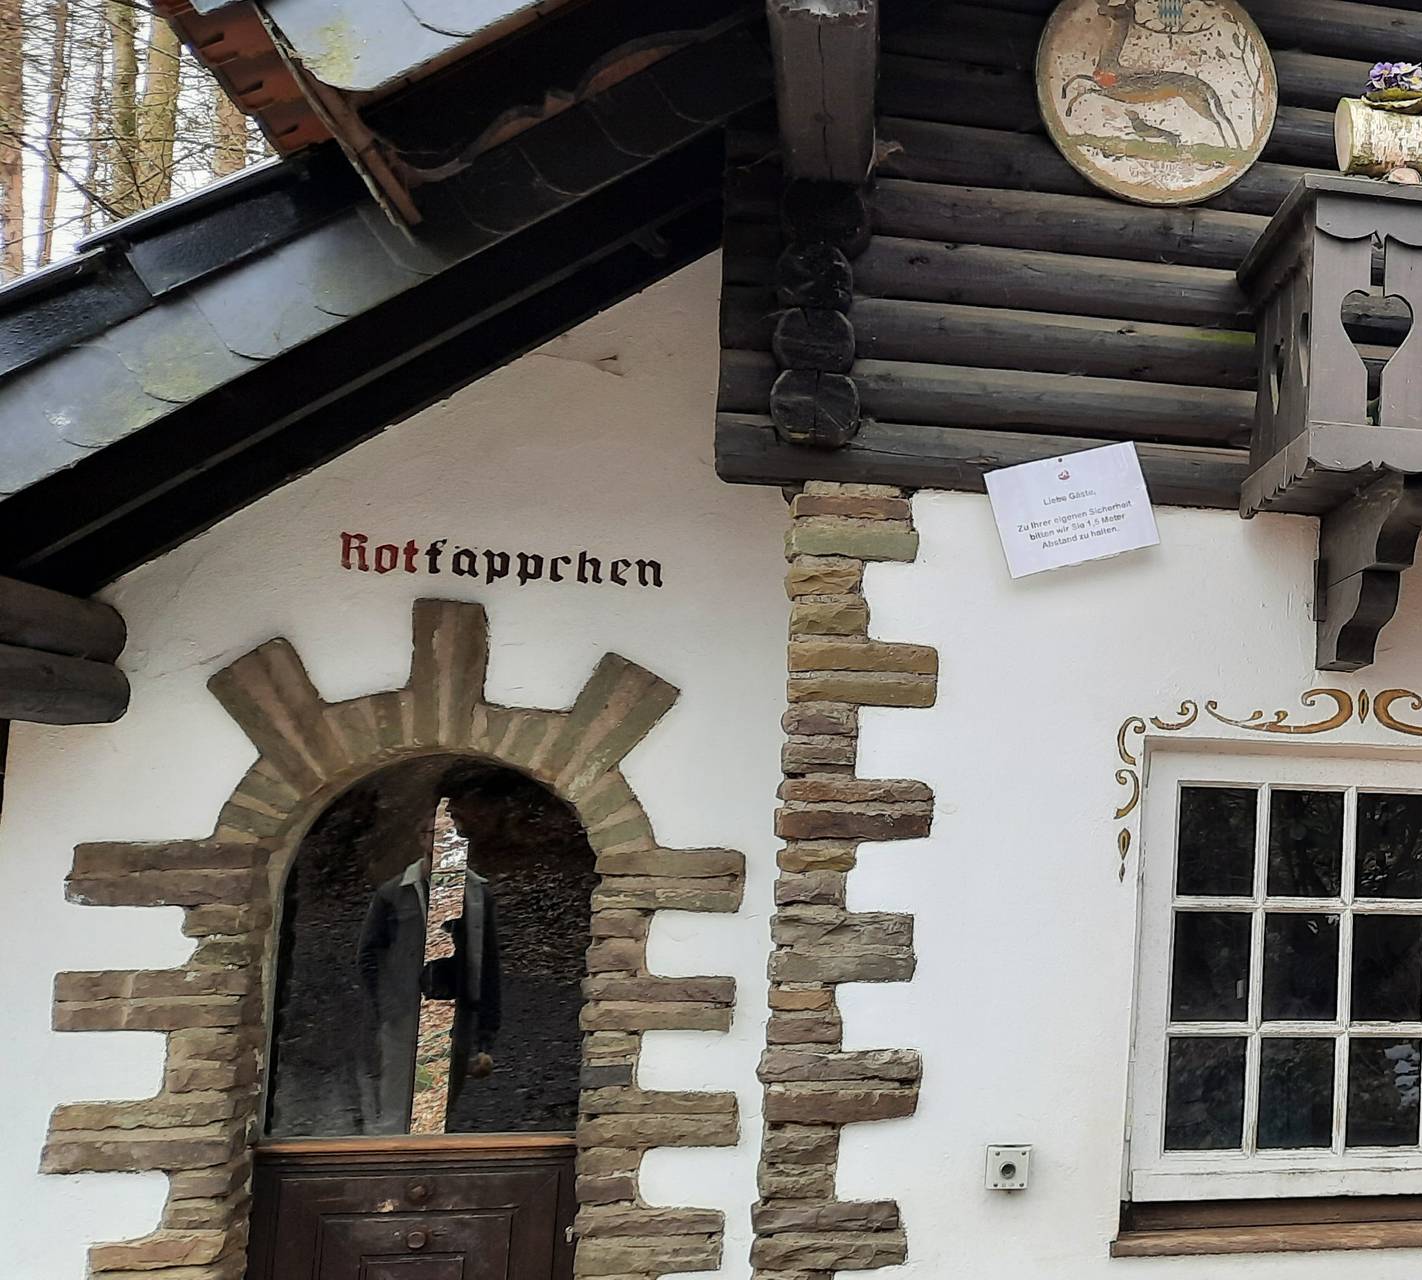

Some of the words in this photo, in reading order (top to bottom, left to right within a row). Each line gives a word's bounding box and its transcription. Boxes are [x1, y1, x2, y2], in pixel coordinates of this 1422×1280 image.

[1043, 495, 1067, 506] Liebe
[1017, 524, 1029, 533] Zu
[1031, 519, 1051, 529] Ihrer
[1054, 511, 1088, 525] eigenen
[1089, 500, 1132, 516] Sicherheit
[1056, 525, 1069, 535] wir
[1101, 512, 1125, 524] Meter
[1042, 534, 1078, 549] Abstand
[1079, 531, 1089, 541] zu
